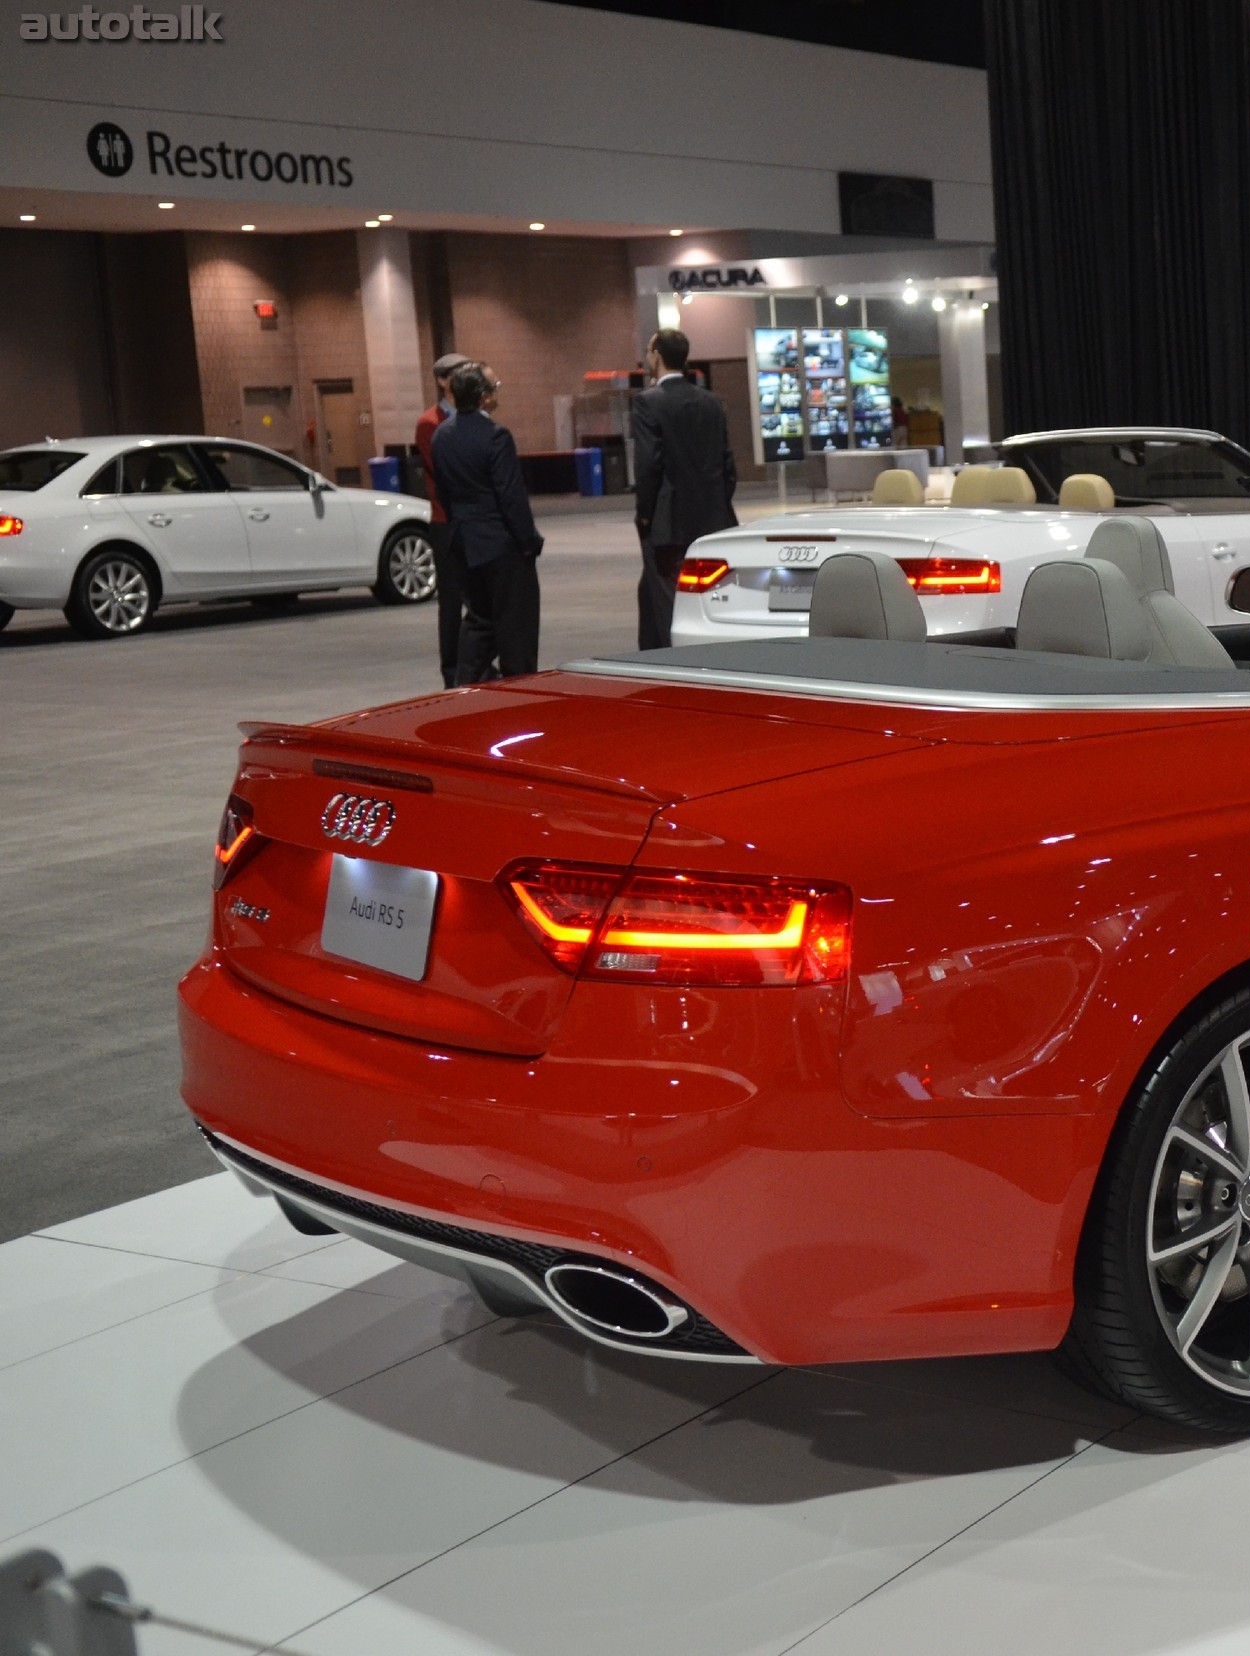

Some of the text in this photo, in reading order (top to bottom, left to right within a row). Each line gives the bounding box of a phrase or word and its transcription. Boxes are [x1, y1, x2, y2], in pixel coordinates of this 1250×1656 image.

[147, 131, 353, 187] Restrooms
[685, 267, 767, 288] ACURA
[350, 896, 405, 929] Audi RS 5
